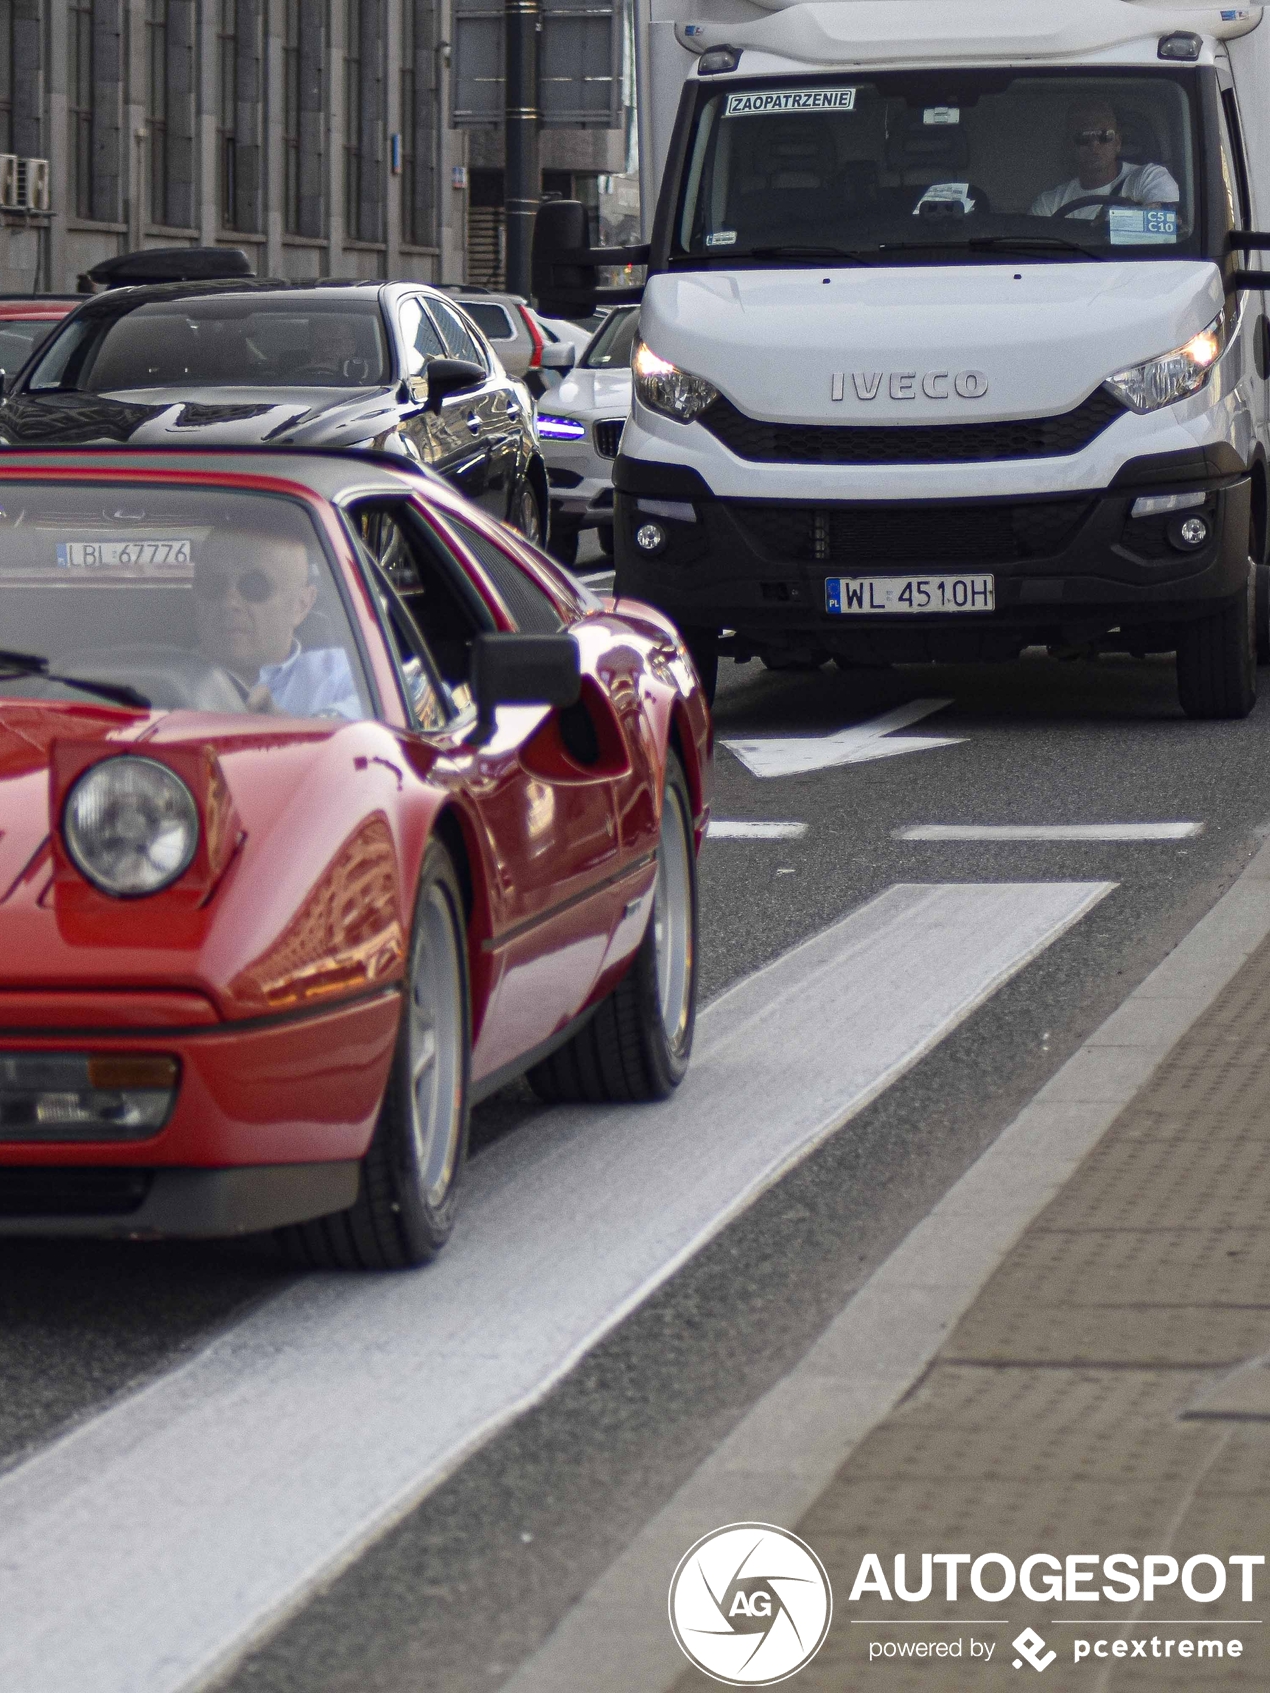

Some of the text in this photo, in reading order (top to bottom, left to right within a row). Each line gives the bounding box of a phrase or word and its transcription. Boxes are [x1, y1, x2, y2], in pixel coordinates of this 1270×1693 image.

[732, 92, 849, 112] ZAOPATRZENIE
[1148, 211, 1164, 221] C5
[1148, 222, 1173, 232] C10
[831, 370, 988, 401] IVECO
[118, 543, 188, 564] 67776
[845, 582, 886, 609] WL
[897, 580, 988, 608] 4510H
